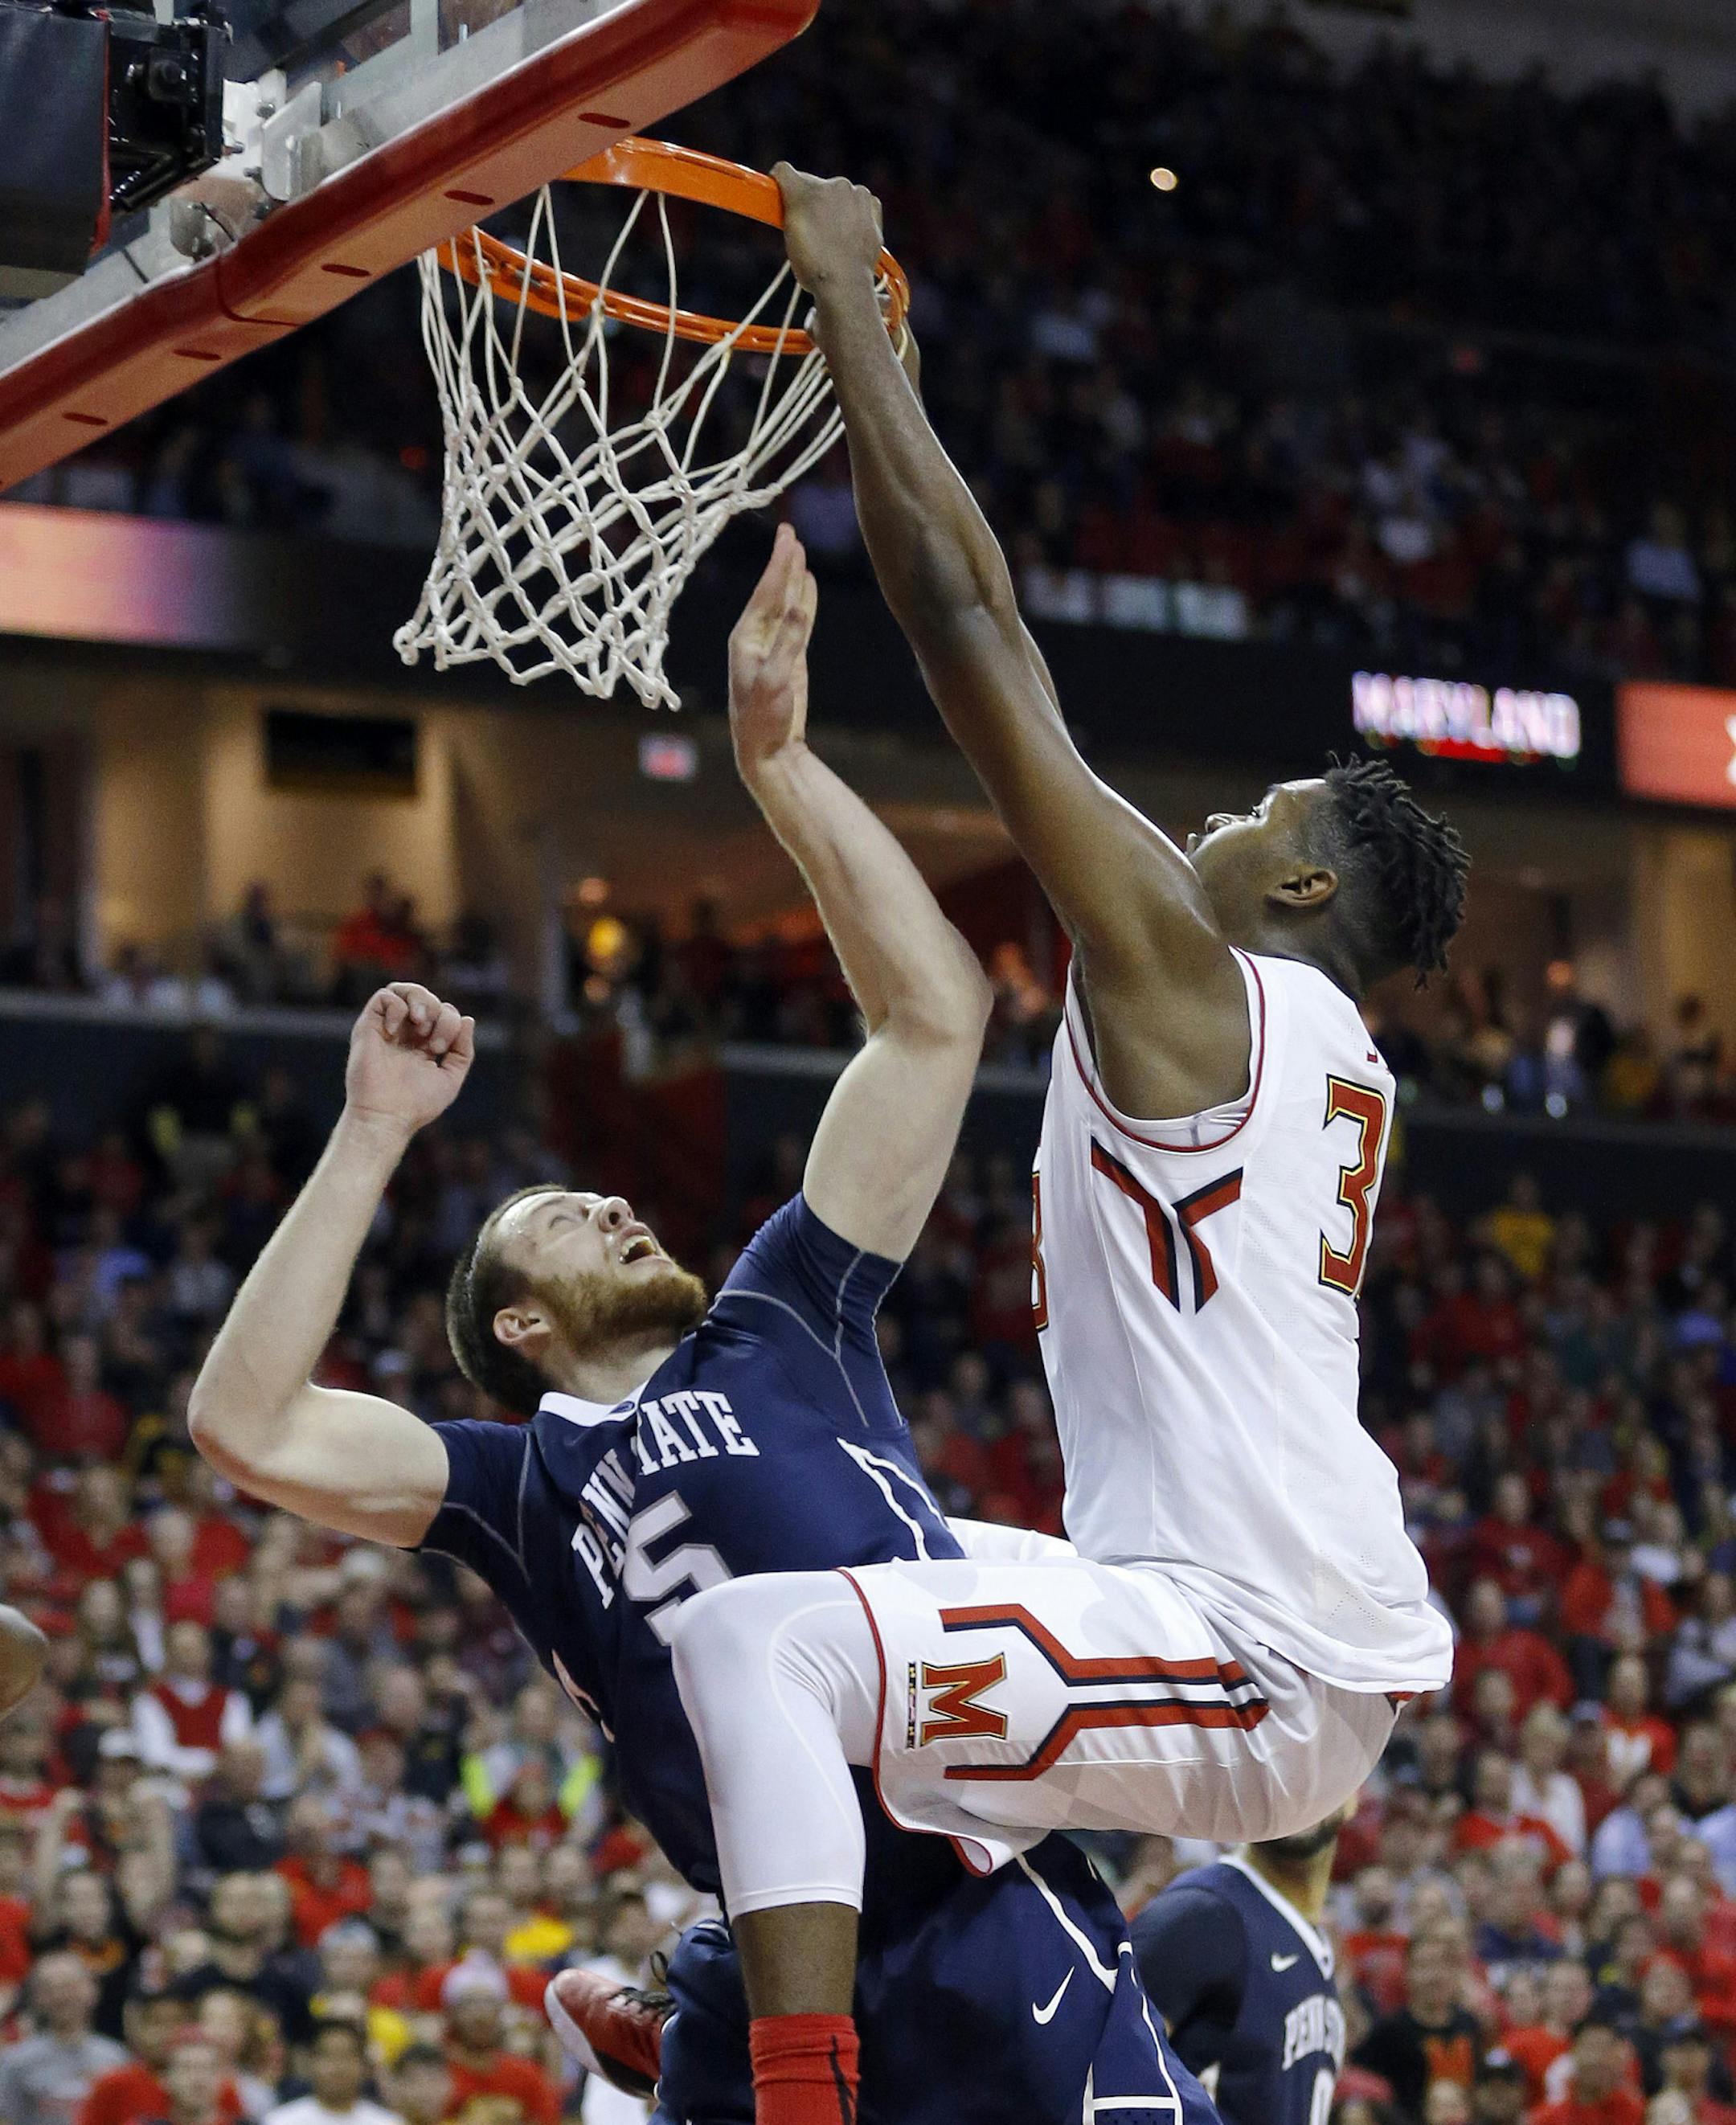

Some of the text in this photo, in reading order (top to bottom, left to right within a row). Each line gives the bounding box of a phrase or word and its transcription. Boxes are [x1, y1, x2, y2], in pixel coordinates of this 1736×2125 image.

[1352, 671, 1581, 758] MARYLAND
[631, 1391, 760, 1476] ATE
[624, 1489, 735, 1646] 5
[920, 1652, 1008, 1747] M
